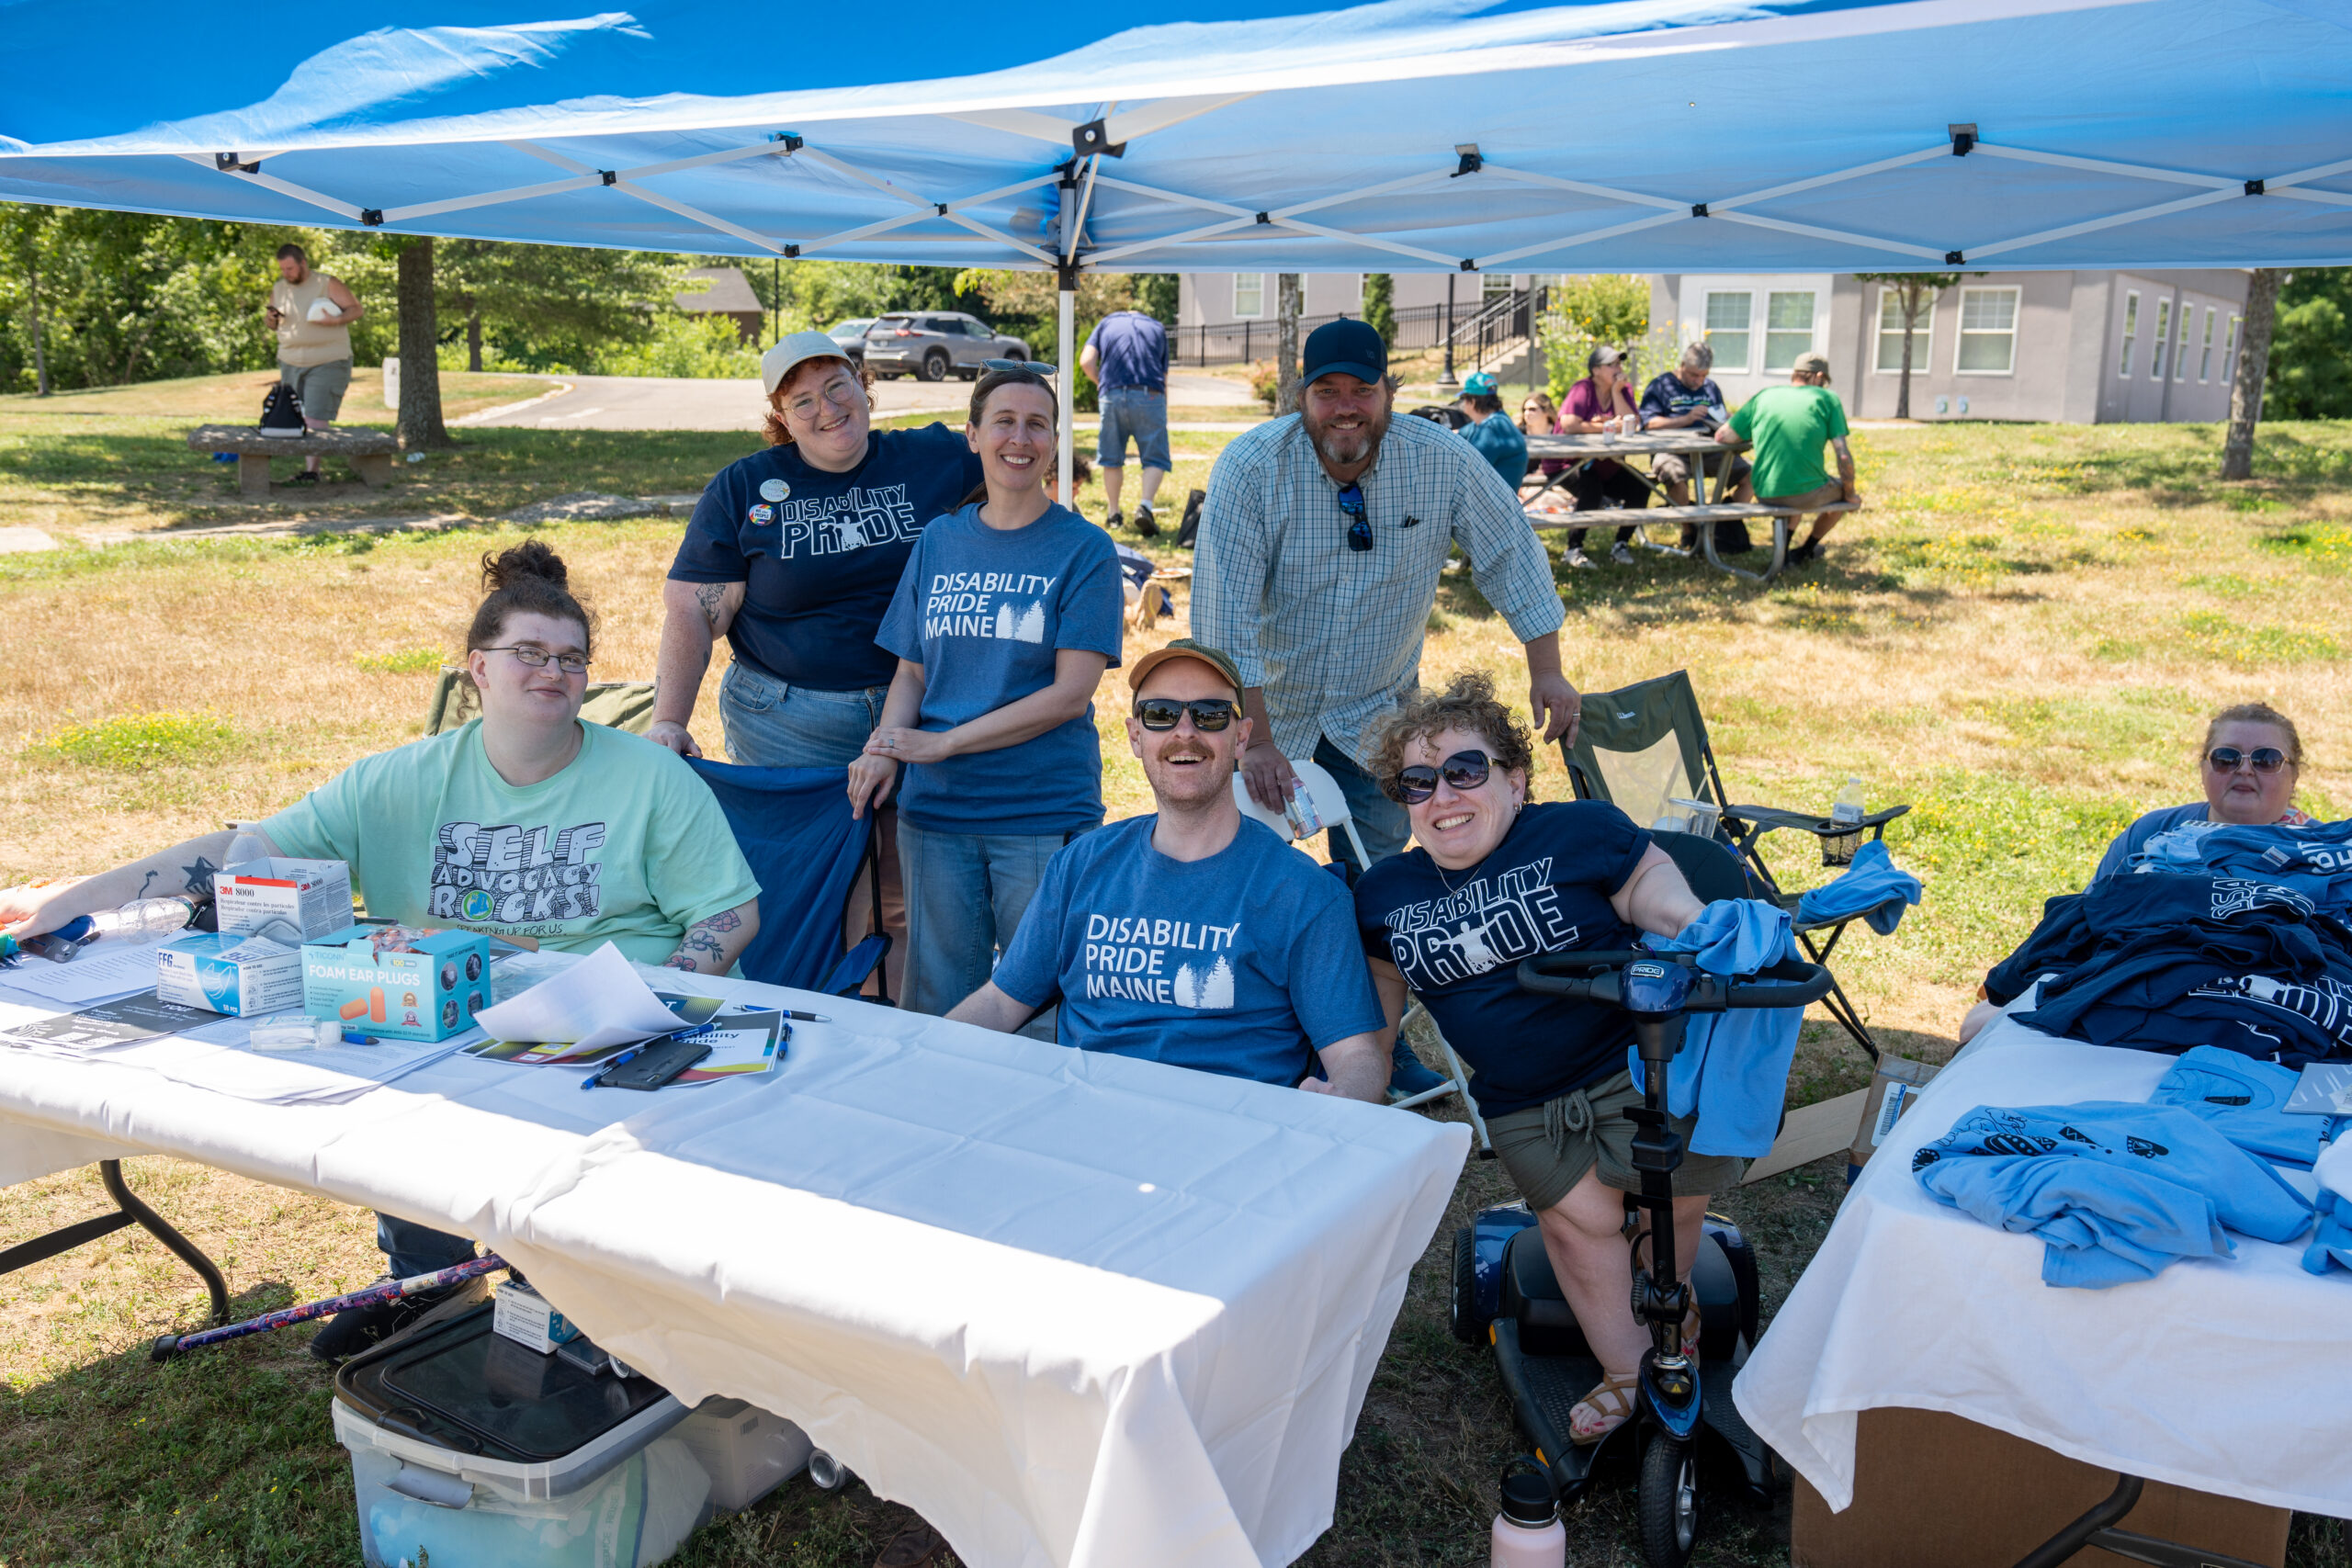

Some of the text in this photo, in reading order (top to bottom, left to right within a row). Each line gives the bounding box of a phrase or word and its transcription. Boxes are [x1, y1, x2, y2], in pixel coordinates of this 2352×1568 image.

[781, 483, 906, 524] DISABILITY
[931, 572, 1057, 595] DISABILITY
[926, 593, 991, 616] PRIDE
[925, 615, 994, 640] MAINE
[435, 822, 605, 872] SELF
[301, 883, 311, 891] 3M
[431, 863, 602, 892] ADVOCACY
[220, 886, 254, 897] 3M 8000
[1385, 856, 1553, 935] DISABILITY
[506, 926, 520, 936] UP
[523, 924, 547, 936] FOR
[548, 923, 563, 934] US
[1087, 914, 1241, 952] DISABILITY
[158, 952, 174, 967] FFG
[1086, 943, 1165, 975] PRIDE
[1634, 966, 1661, 975] PRIDE
[309, 964, 421, 987] FOAM EAR PLUGS
[1087, 974, 1173, 1004] MAINE
